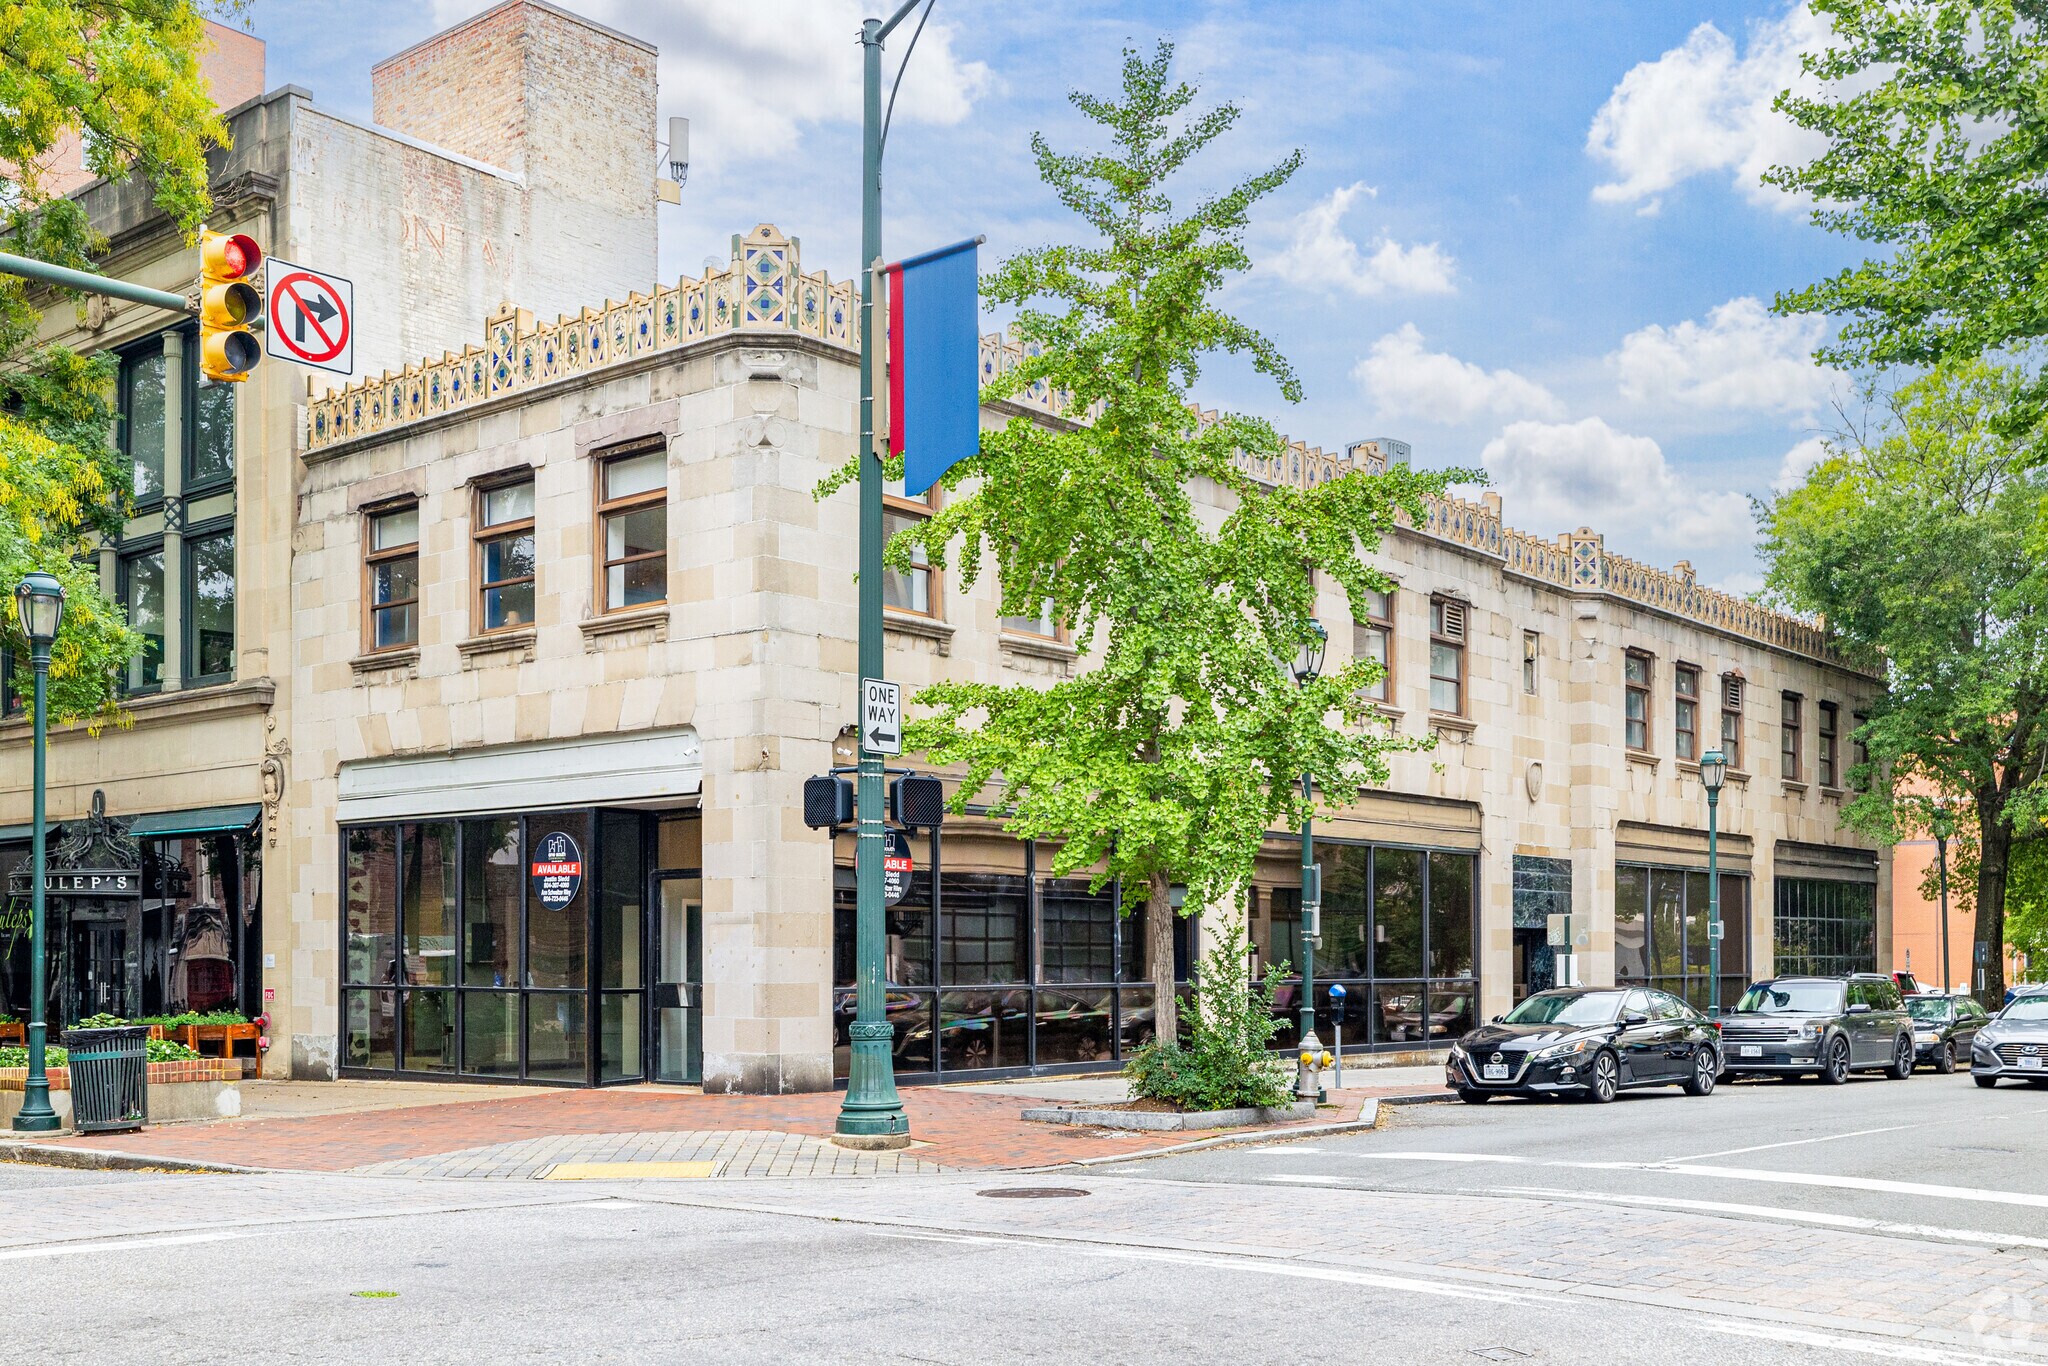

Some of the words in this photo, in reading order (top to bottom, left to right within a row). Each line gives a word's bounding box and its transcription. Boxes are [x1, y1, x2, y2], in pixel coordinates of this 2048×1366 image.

[870, 686, 895, 704] ONE
[868, 705, 895, 723] WAY
[93, 797, 100, 814] J
[537, 864, 576, 874] AVAILABLE
[31, 876, 127, 889] ULEP'S
